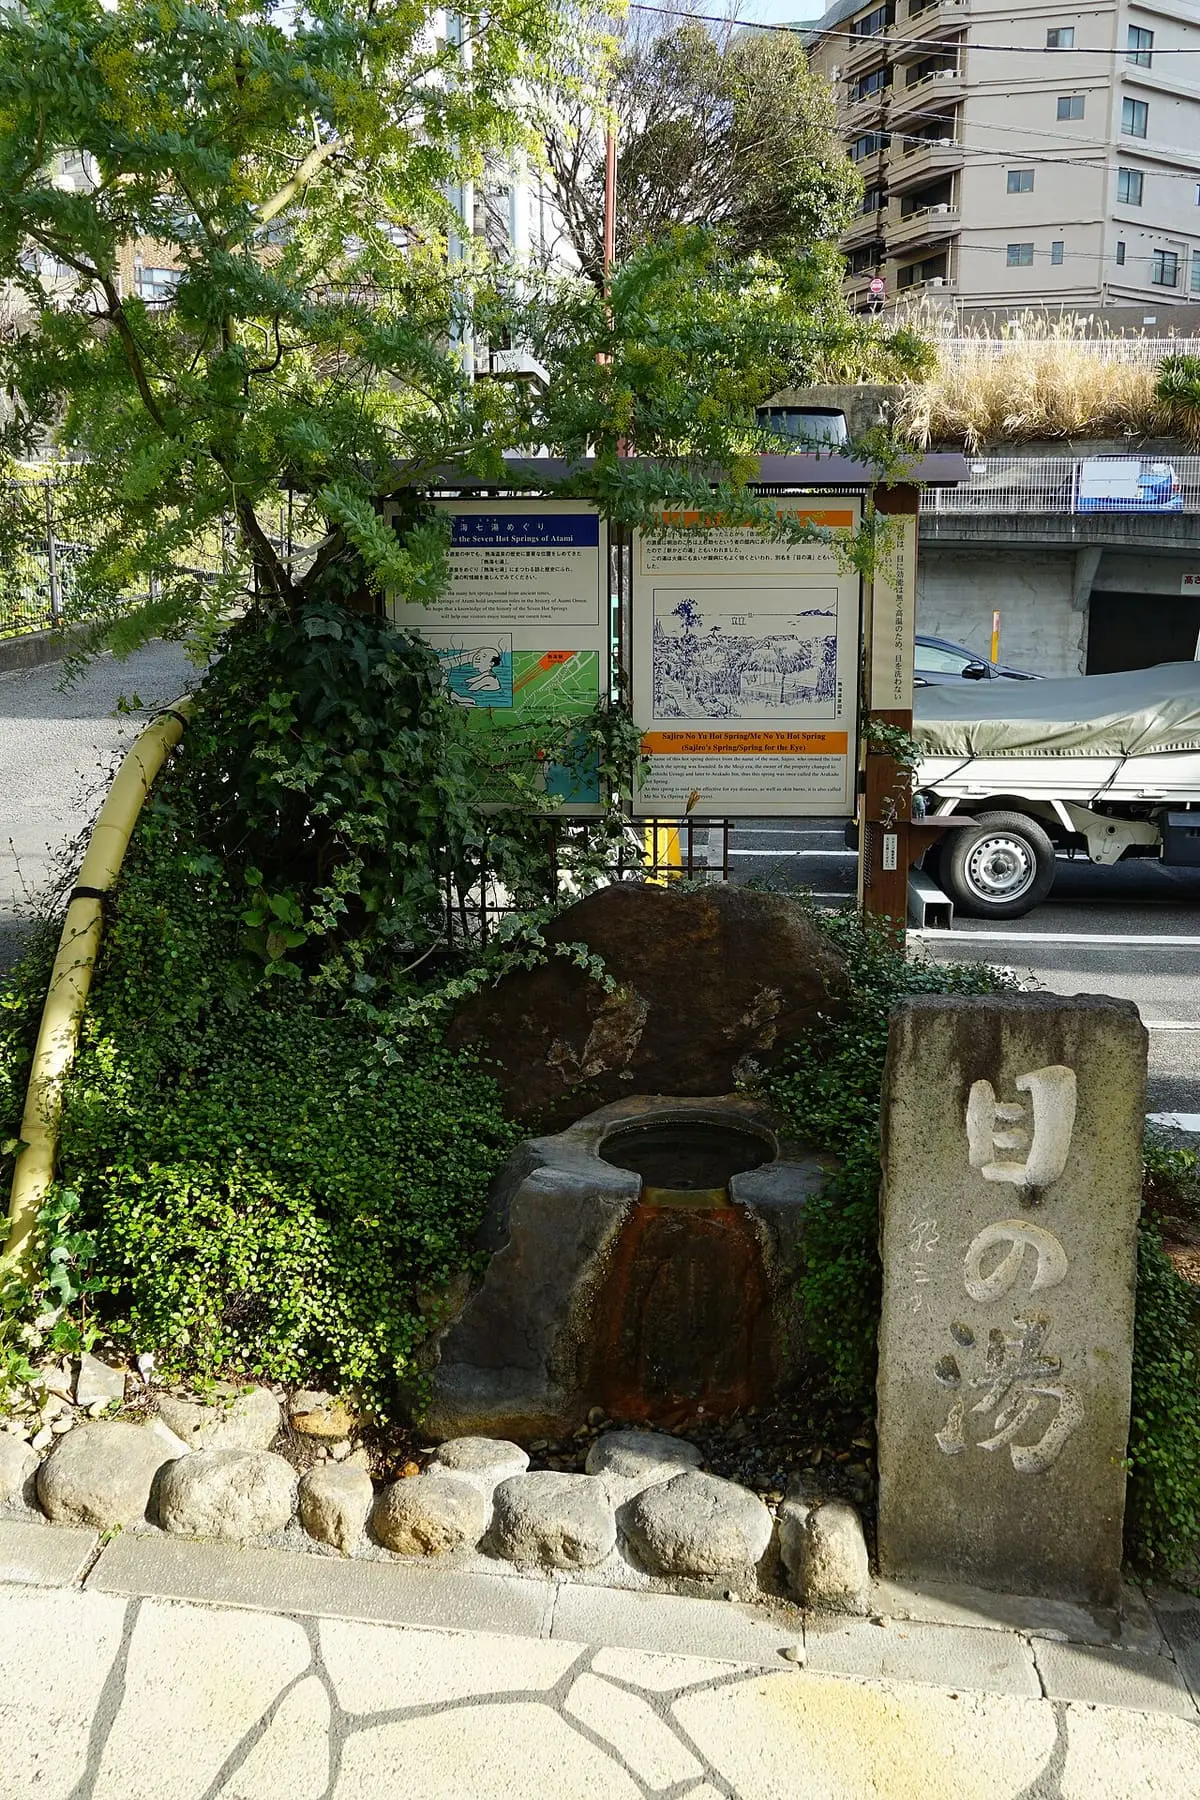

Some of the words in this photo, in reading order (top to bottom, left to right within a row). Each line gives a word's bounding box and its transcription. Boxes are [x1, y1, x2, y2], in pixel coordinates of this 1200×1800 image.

[511, 535, 539, 544] Springs
[790, 744, 806, 752] Eye)
[934, 1064, 1084, 1475] 目の湯
